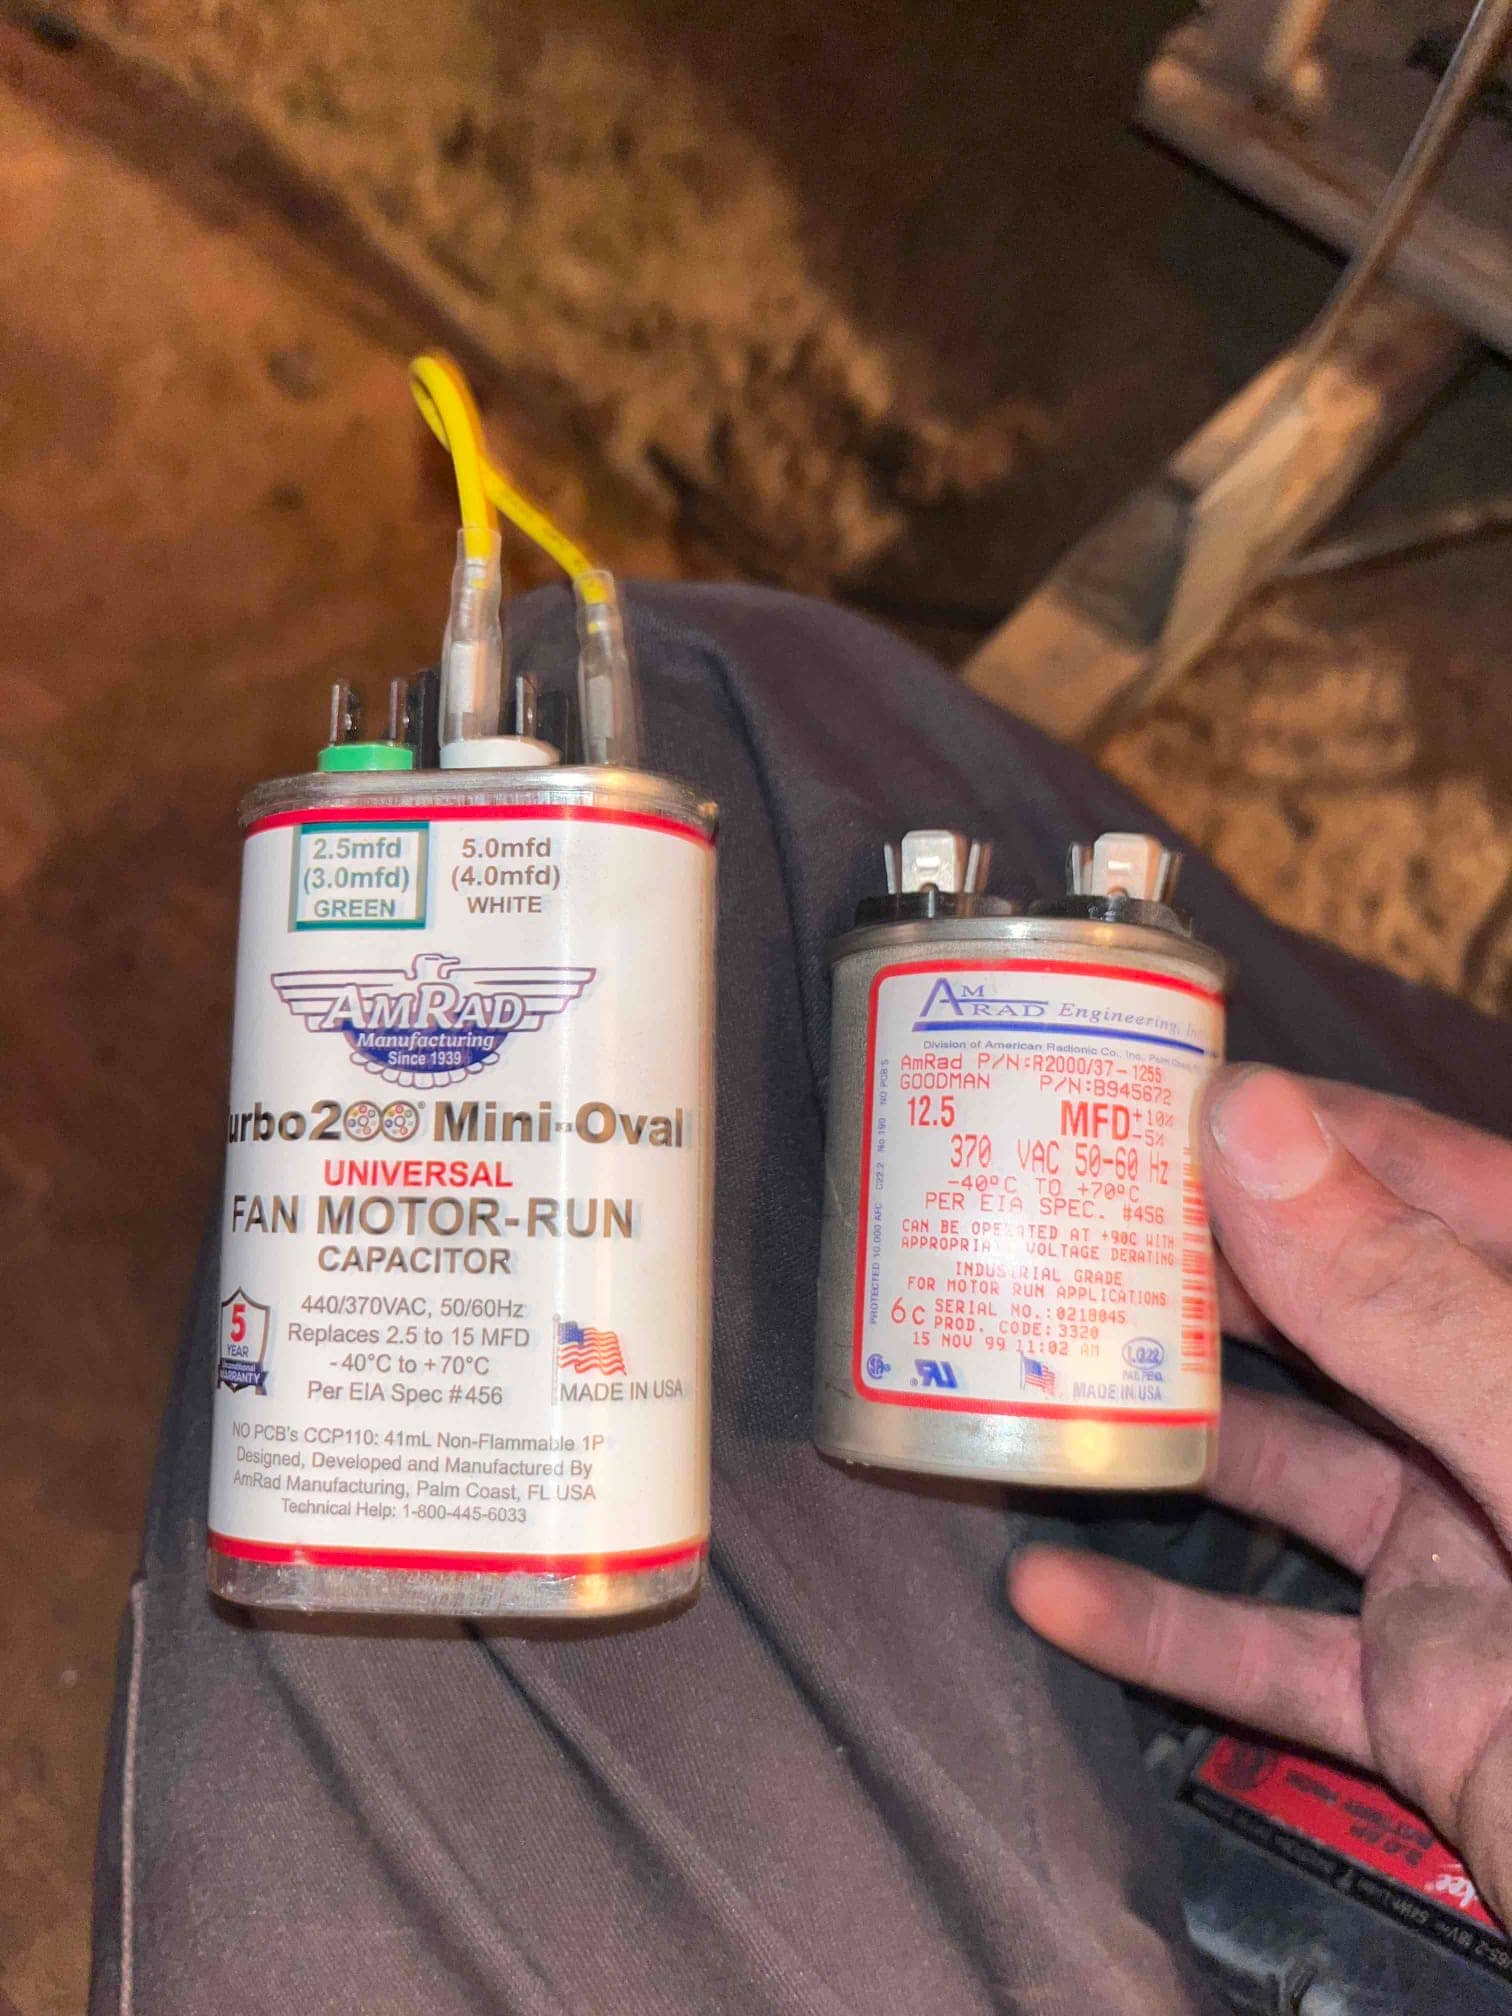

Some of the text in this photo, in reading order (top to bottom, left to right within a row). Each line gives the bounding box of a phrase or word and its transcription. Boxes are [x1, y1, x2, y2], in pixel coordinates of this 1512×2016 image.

[313, 837, 402, 860] 2.5mfd
[462, 838, 552, 859] 5.0mfd
[303, 865, 410, 894] (3.0mfd)
[451, 864, 561, 892] (4.0mfd)
[313, 898, 395, 919] GREEN
[467, 895, 543, 914] WHITE
[356, 1030, 495, 1051] Manufacturing
[924, 1040, 966, 1050] Division
[970, 1039, 981, 1050] of
[985, 1040, 1042, 1052] American
[1046, 1042, 1098, 1057] Radionic
[387, 1051, 462, 1066] Since 1939
[900, 1053, 963, 1072] AmRad
[900, 1072, 990, 1090] GOODMAN
[434, 1099, 685, 1148] Mini-Oval
[908, 1094, 955, 1128] 12.5
[1061, 1099, 1131, 1141] MFD
[950, 1134, 1169, 1186] 370 VAC 50-60 Hz
[324, 1160, 513, 1188] UNIVERSAL
[1036, 1177, 1062, 1197] TO
[233, 1195, 634, 1239] FAN MOTOR-RUN
[925, 1191, 1165, 1225] PER EIA SPEC. #456
[902, 1218, 1176, 1250] CAN BE OPEATED AT +90C WITH
[318, 1246, 511, 1275] CAPACITOR
[901, 1235, 1175, 1267] APPROPRIA VOLTAGE DERATING
[1073, 1268, 1124, 1287] GRADE
[869, 1262, 880, 1325] PROTECTED
[908, 1276, 1169, 1307] FOR MOTOR RUN APPLICATIONS
[301, 1295, 524, 1320] 440/370VAC, 50/60Hz
[935, 1298, 997, 1317] SERIAL
[230, 1303, 247, 1342] 5
[288, 1323, 530, 1347] Replaces 2.5 to 15 MFD
[934, 1315, 984, 1333] PROD.
[227, 1343, 249, 1358] YEAR
[913, 1331, 1100, 1358] 15 NOV 99 11:02 AM
[399, 1354, 417, 1374] to
[307, 1381, 503, 1407] Per EIA Spec #456
[560, 1379, 684, 1403] MADE IN USA
[1073, 1381, 1162, 1400] MADE IN USA
[232, 1421, 605, 1451] NO PCB's CCP110: 41mL Non-Flammable 1P
[236, 1445, 593, 1480] Designed, Developed and Manufactured By
[233, 1469, 597, 1502] AmRad Manufacturing, Palm Coast, FL USA
[282, 1498, 527, 1524] Technical Help: 1-800-445-6033
